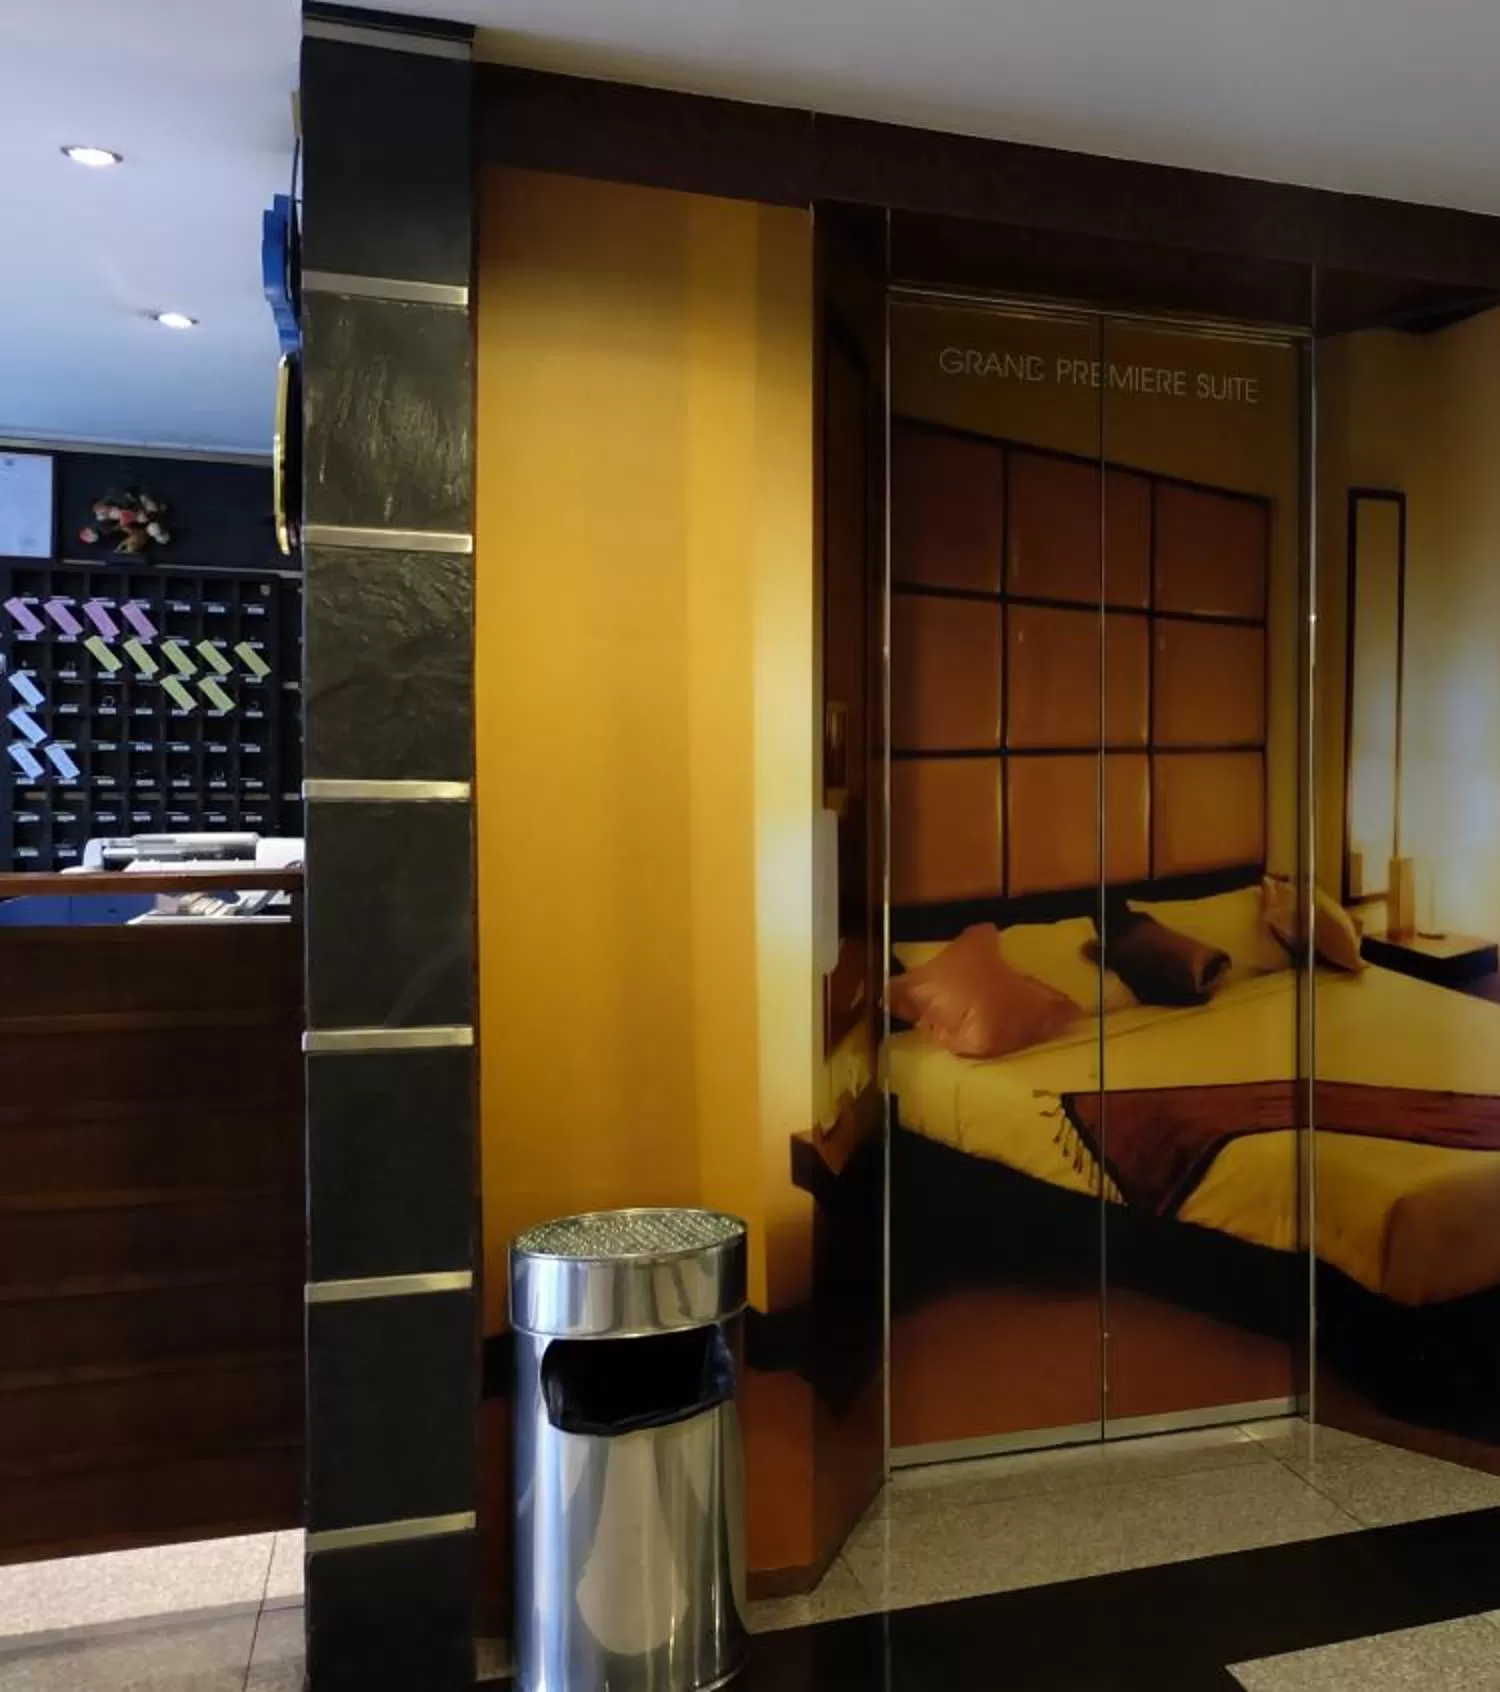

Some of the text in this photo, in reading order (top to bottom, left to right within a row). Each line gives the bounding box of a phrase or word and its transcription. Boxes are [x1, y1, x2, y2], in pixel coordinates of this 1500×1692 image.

[939, 347, 1261, 404] GRAND PREMIERE SUITE
